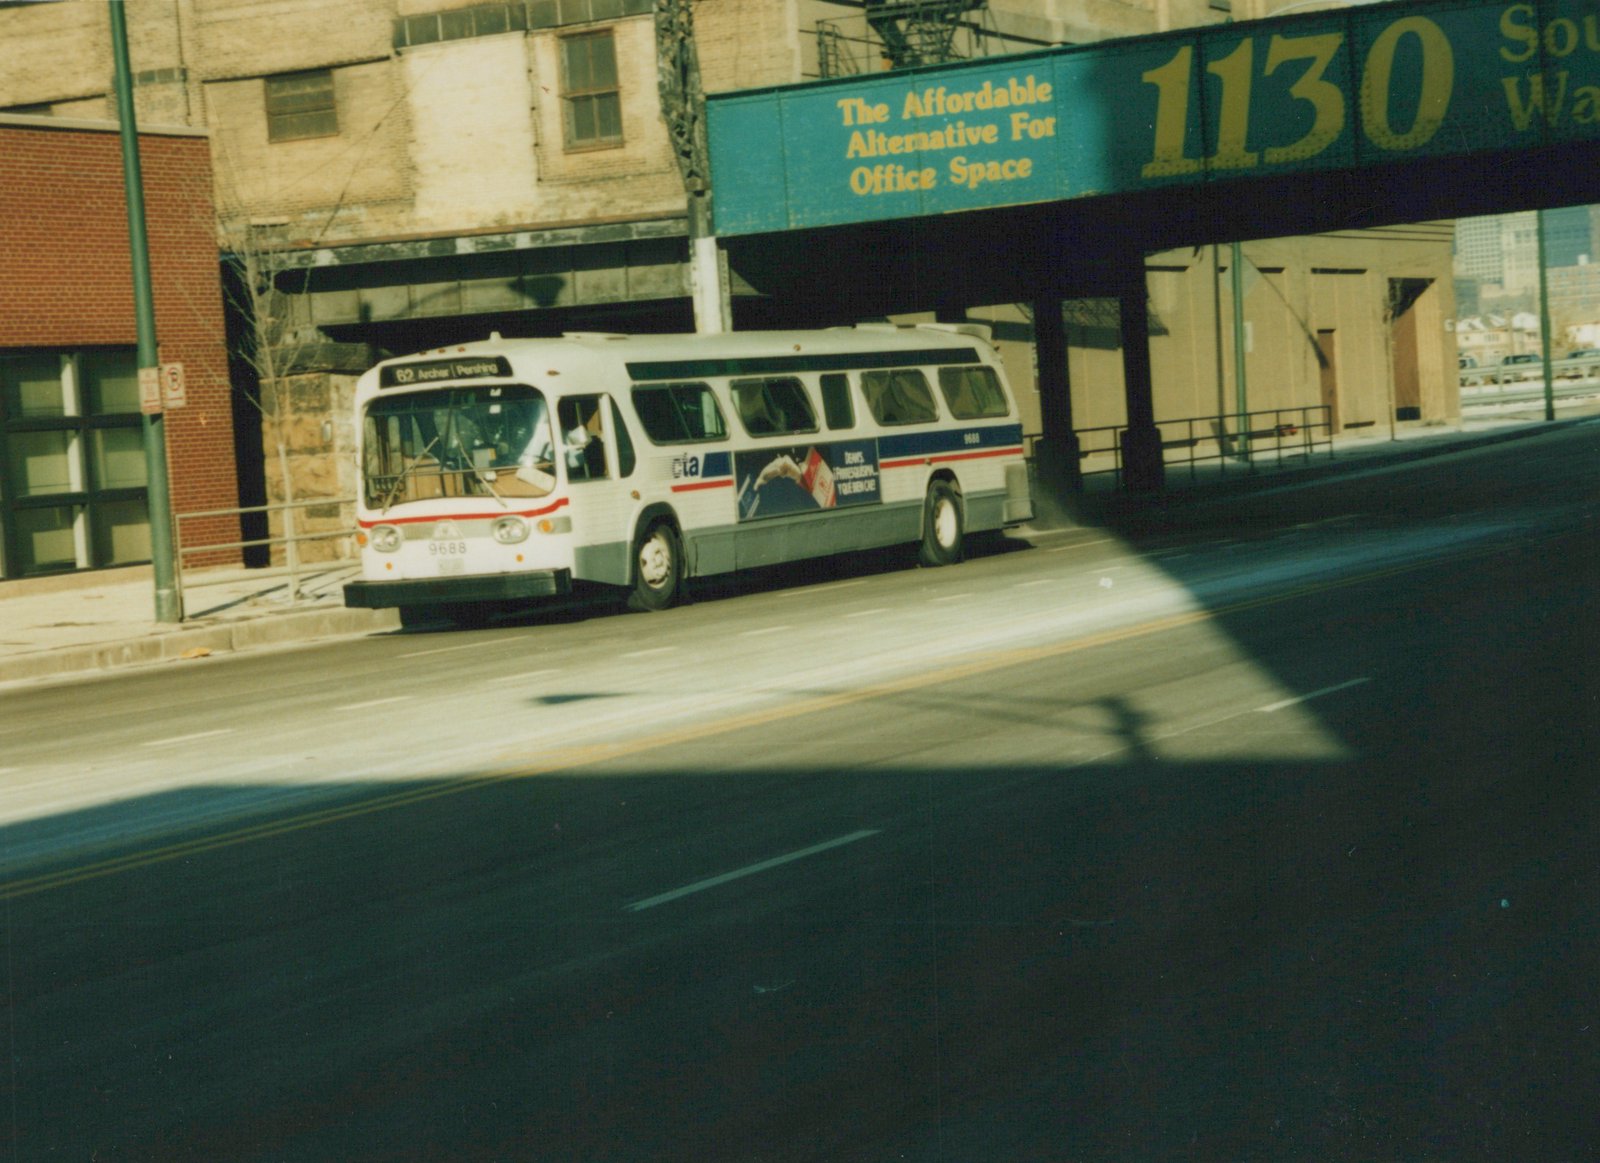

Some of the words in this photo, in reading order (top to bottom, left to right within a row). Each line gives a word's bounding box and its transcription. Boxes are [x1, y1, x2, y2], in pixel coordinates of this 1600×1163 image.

[837, 97, 890, 126] The
[902, 74, 1053, 120] Affordable
[1141, 15, 1455, 179] 1130
[1501, 71, 1600, 131] Wa
[846, 121, 998, 159] Alternative
[1009, 111, 1056, 141] For
[850, 164, 937, 195] Office
[949, 156, 1033, 189] Space
[396, 368, 415, 383] 62
[418, 368, 449, 380] Archer
[429, 542, 467, 555] 9688
